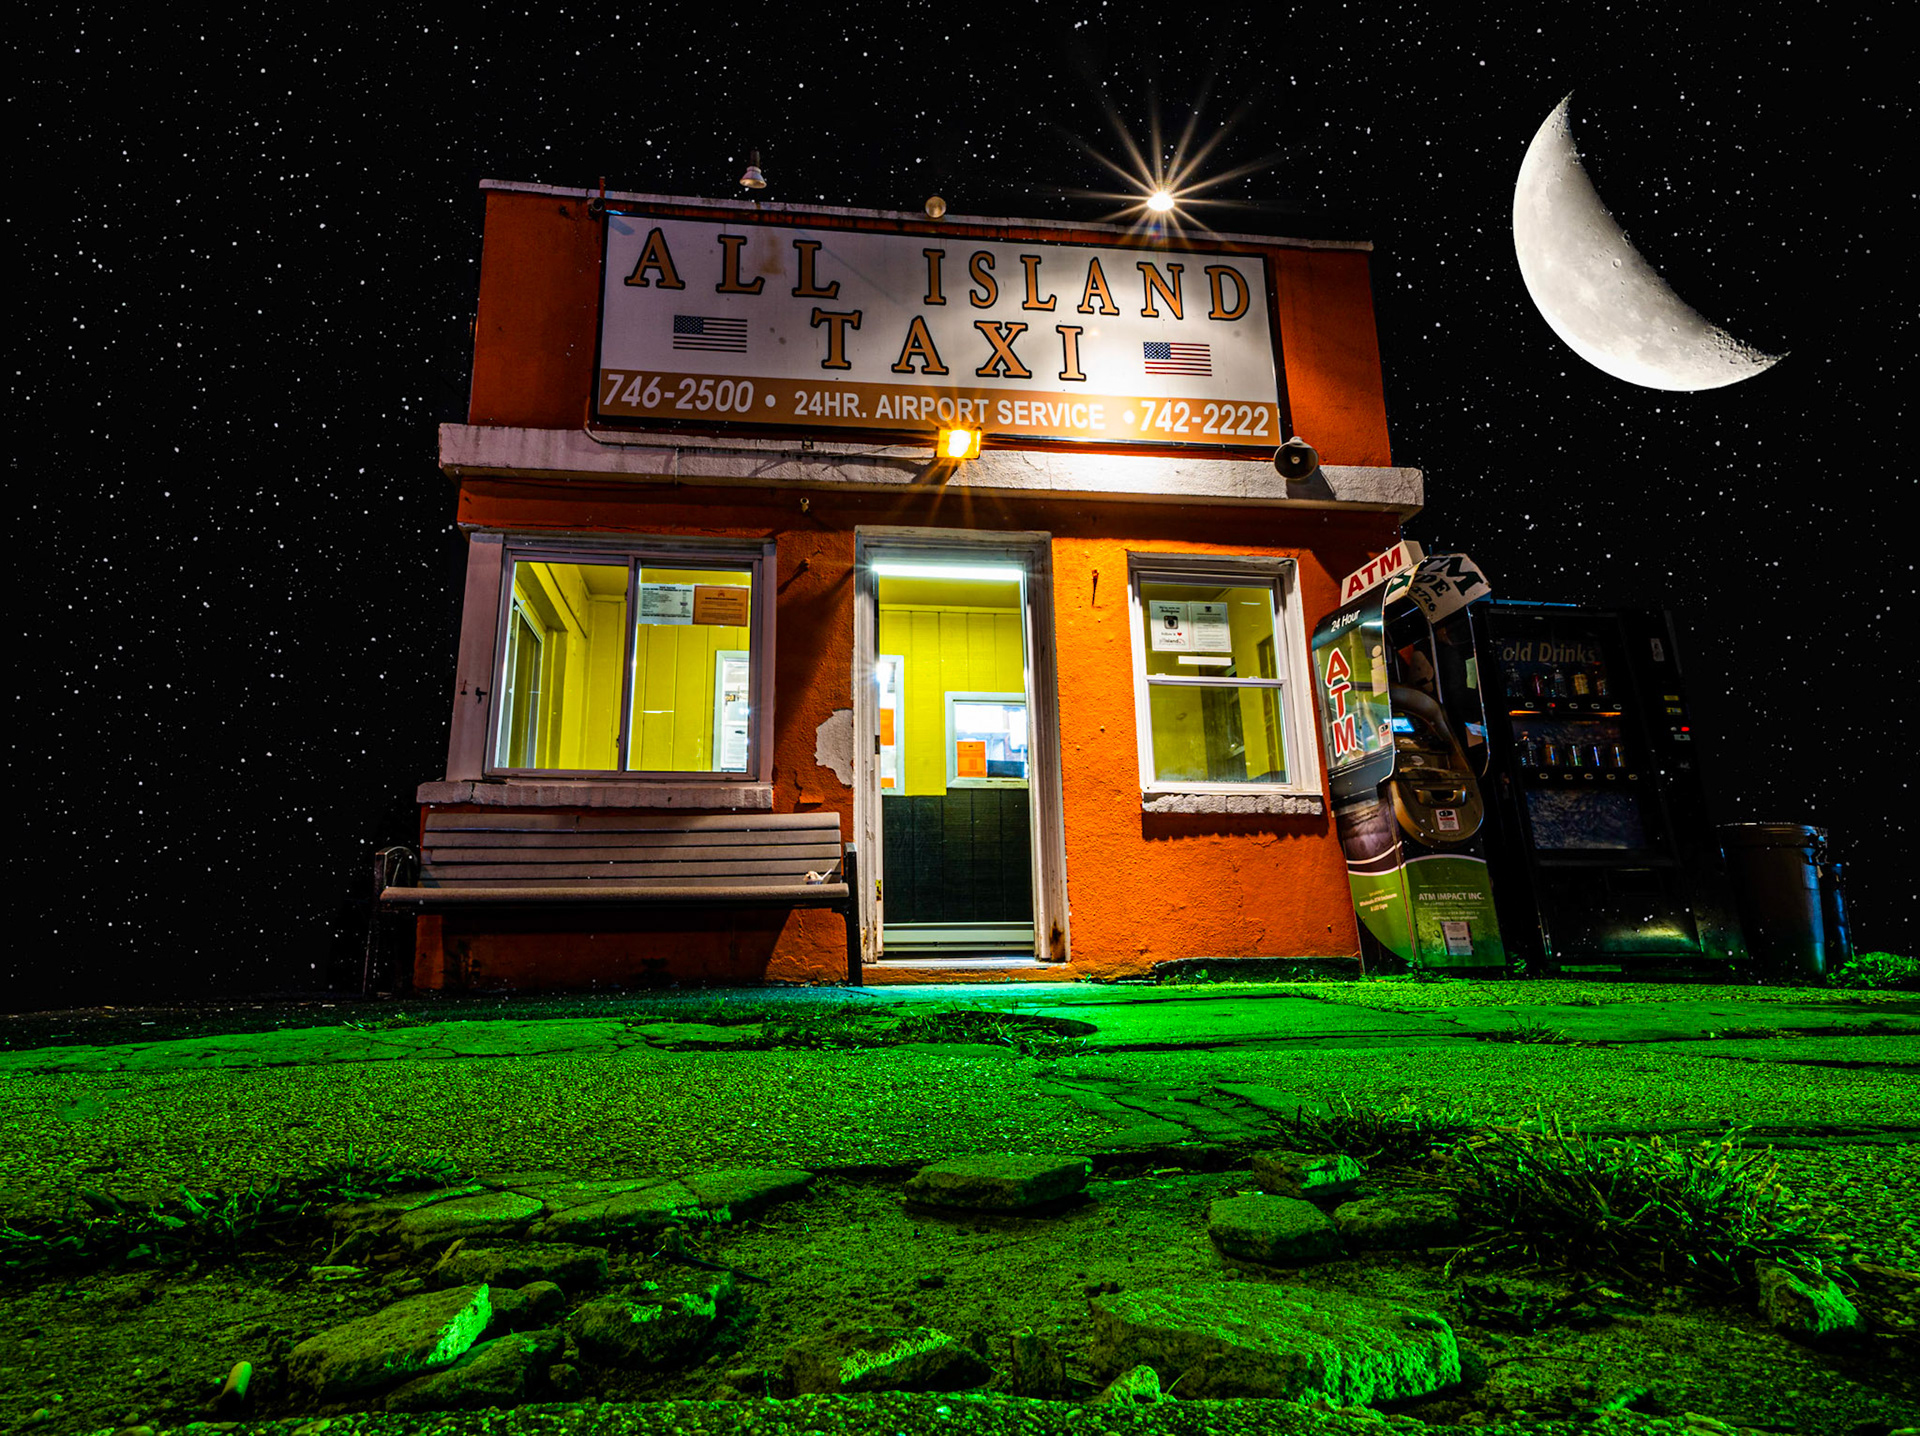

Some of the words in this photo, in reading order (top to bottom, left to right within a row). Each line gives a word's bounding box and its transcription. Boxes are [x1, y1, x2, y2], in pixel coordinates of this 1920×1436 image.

[624, 226, 841, 300] ALL
[922, 248, 1251, 322] ISLAND
[810, 307, 1087, 382] TAXI
[603, 373, 754, 414] 746-2500
[794, 390, 868, 419] 24HR.
[875, 395, 990, 424] AIRPORT
[997, 399, 1106, 430] SERVICE
[1140, 400, 1269, 437] 742-2222
[1347, 547, 1403, 599] ATM
[1331, 619, 1341, 633] 24
[1341, 610, 1361, 629] Hour
[1538, 641, 1597, 664] Drinks
[1325, 647, 1358, 758] ATM
[1418, 892, 1437, 901] ATM
[1437, 892, 1467, 901] IMPACT
[1468, 891, 1486, 901] INC.
